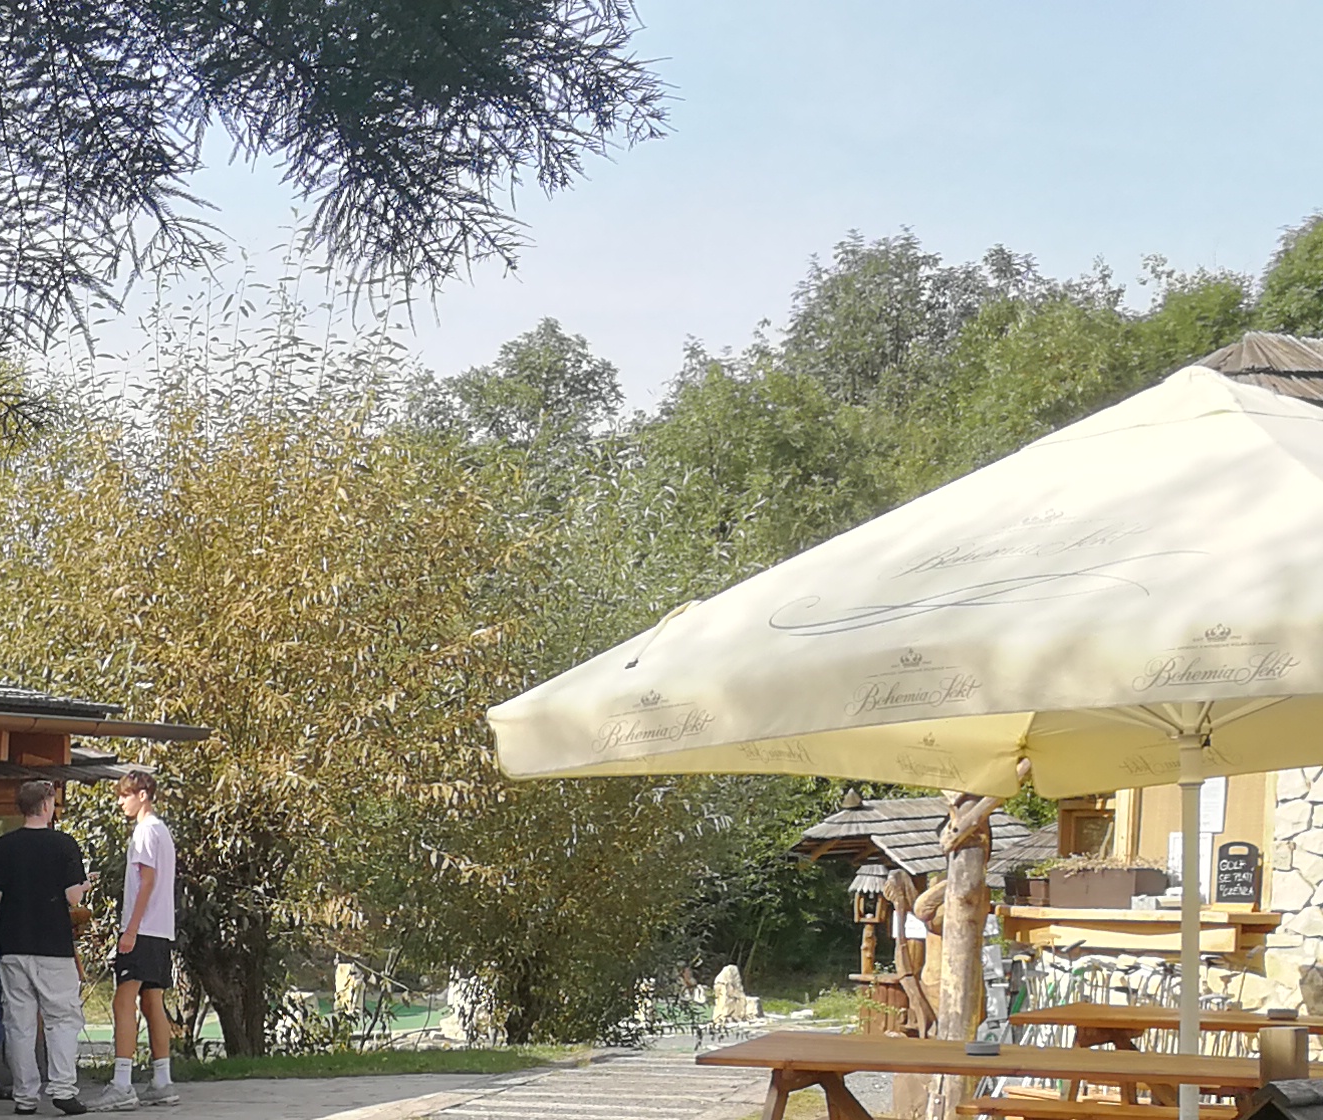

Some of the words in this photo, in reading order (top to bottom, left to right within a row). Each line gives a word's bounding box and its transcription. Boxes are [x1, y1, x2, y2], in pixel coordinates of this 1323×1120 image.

[1132, 655, 1236, 692] Bohemia
[1235, 650, 1301, 686] Sekt
[844, 681, 929, 716] Bohemia
[928, 673, 982, 708] Sekt
[591, 719, 669, 753] Bohemia
[669, 708, 716, 742] Sekt
[1218, 873, 1232, 883] SE
[1219, 859, 1247, 871] GOLF
